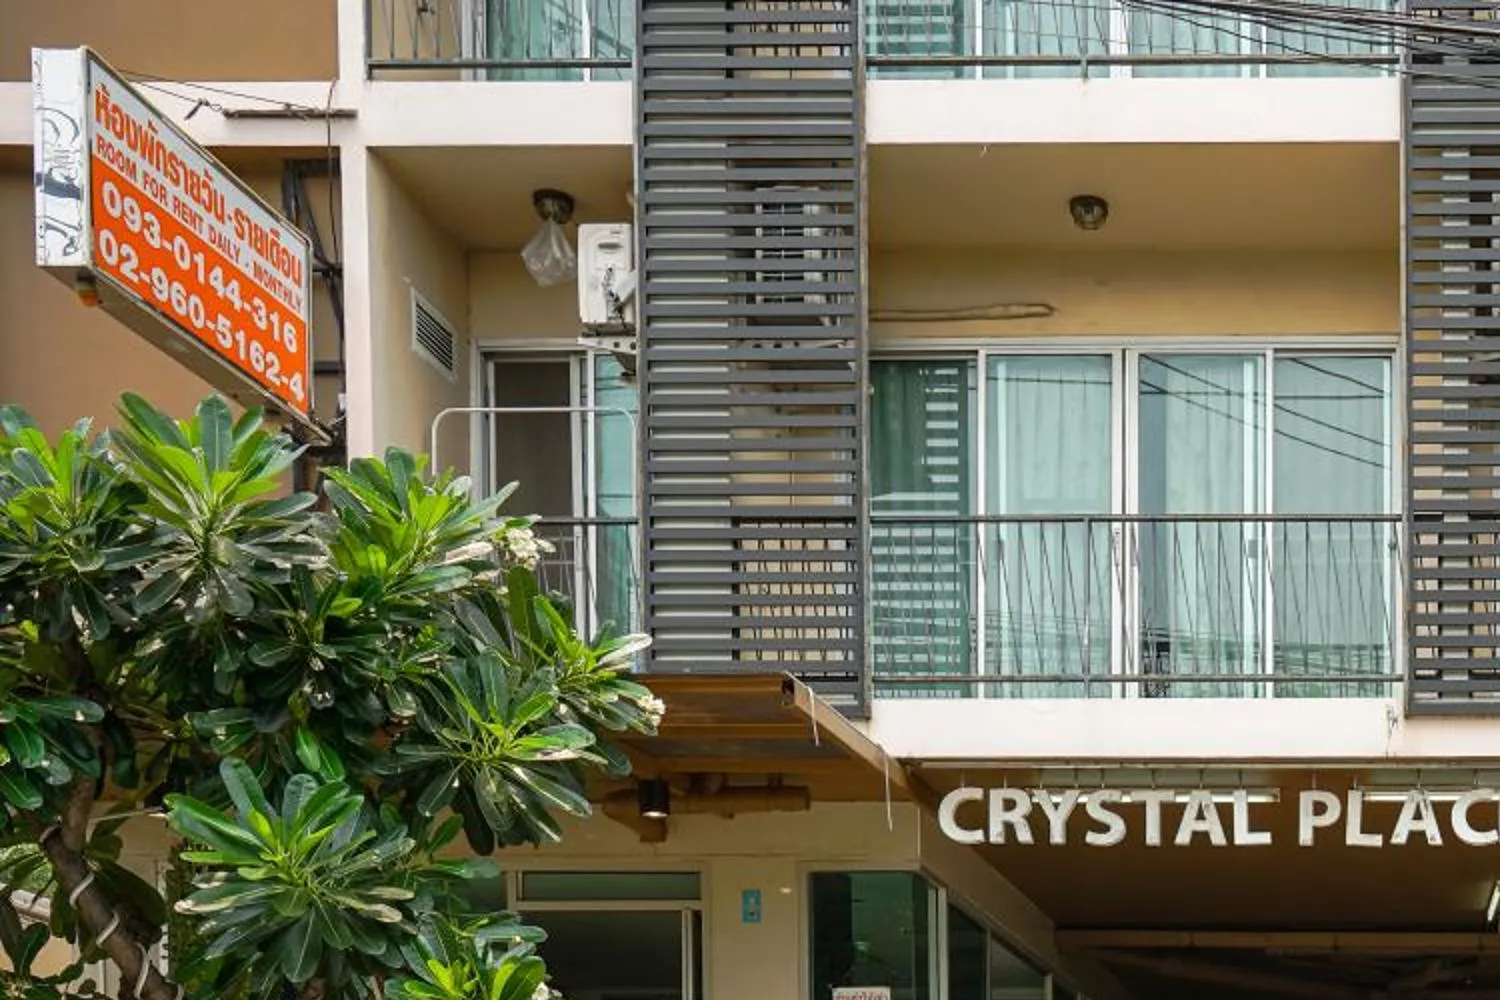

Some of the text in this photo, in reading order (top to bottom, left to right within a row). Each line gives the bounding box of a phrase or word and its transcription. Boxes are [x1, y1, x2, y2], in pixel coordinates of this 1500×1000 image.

[96, 132, 137, 181] ROOM
[143, 169, 168, 206] FOR
[173, 195, 204, 235] RENT
[208, 223, 241, 263] DAILY
[102, 181, 298, 354] 093-0144-316
[98, 229, 305, 402] 02-960-5162-4
[937, 786, 1273, 847] CRYSTAL
